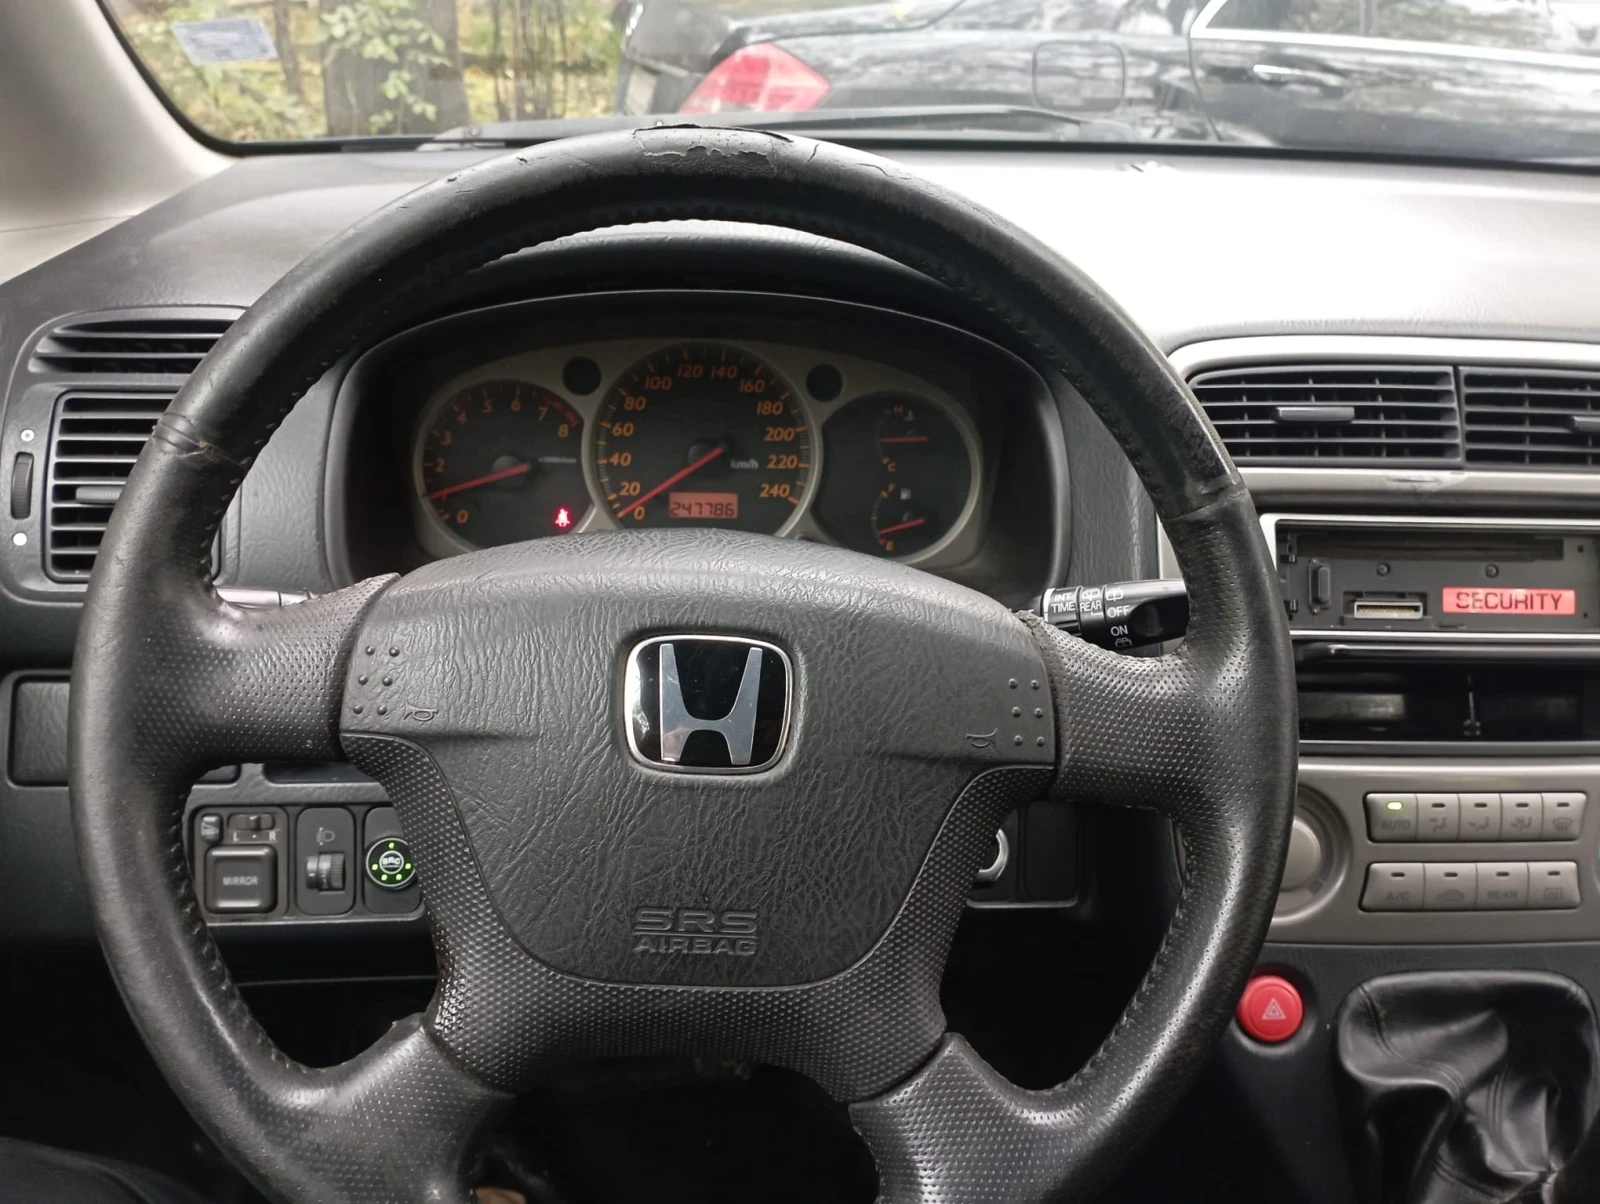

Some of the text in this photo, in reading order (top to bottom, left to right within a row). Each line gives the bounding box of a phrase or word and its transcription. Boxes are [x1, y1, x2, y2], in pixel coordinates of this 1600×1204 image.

[677, 364, 704, 378] 120
[710, 365, 738, 379] 140
[644, 376, 672, 390] 100
[739, 379, 765, 393] 160
[481, 398, 493, 413] 5
[510, 399, 521, 412] 6
[624, 396, 647, 411] 80
[756, 401, 784, 415] 180
[456, 410, 468, 424] 4
[538, 406, 549, 421] 7
[557, 423, 569, 438] 8
[612, 422, 634, 437] 60
[763, 427, 795, 441] 200
[440, 430, 453, 445] 3
[435, 458, 445, 472] 2
[609, 452, 632, 466] 40
[767, 455, 798, 469] 220
[619, 482, 641, 496] 20
[759, 483, 790, 498] 240
[633, 506, 645, 520] 0
[670, 502, 735, 516] 247786
[456, 509, 469, 524] 0
[1054, 592, 1073, 602] INT
[1455, 591, 1564, 611] SECURITY
[1051, 602, 1077, 614] TIME
[1079, 600, 1102, 612] REAR
[1107, 605, 1130, 618] OFF
[1110, 625, 1129, 636] ON
[1381, 820, 1411, 831] AUTO
[233, 832, 240, 841] L
[269, 831, 277, 841] R
[222, 876, 258, 885] MIRROR
[1385, 891, 1411, 902] A/C
[634, 908, 758, 933] SRS
[632, 936, 759, 955] AIRBAG
